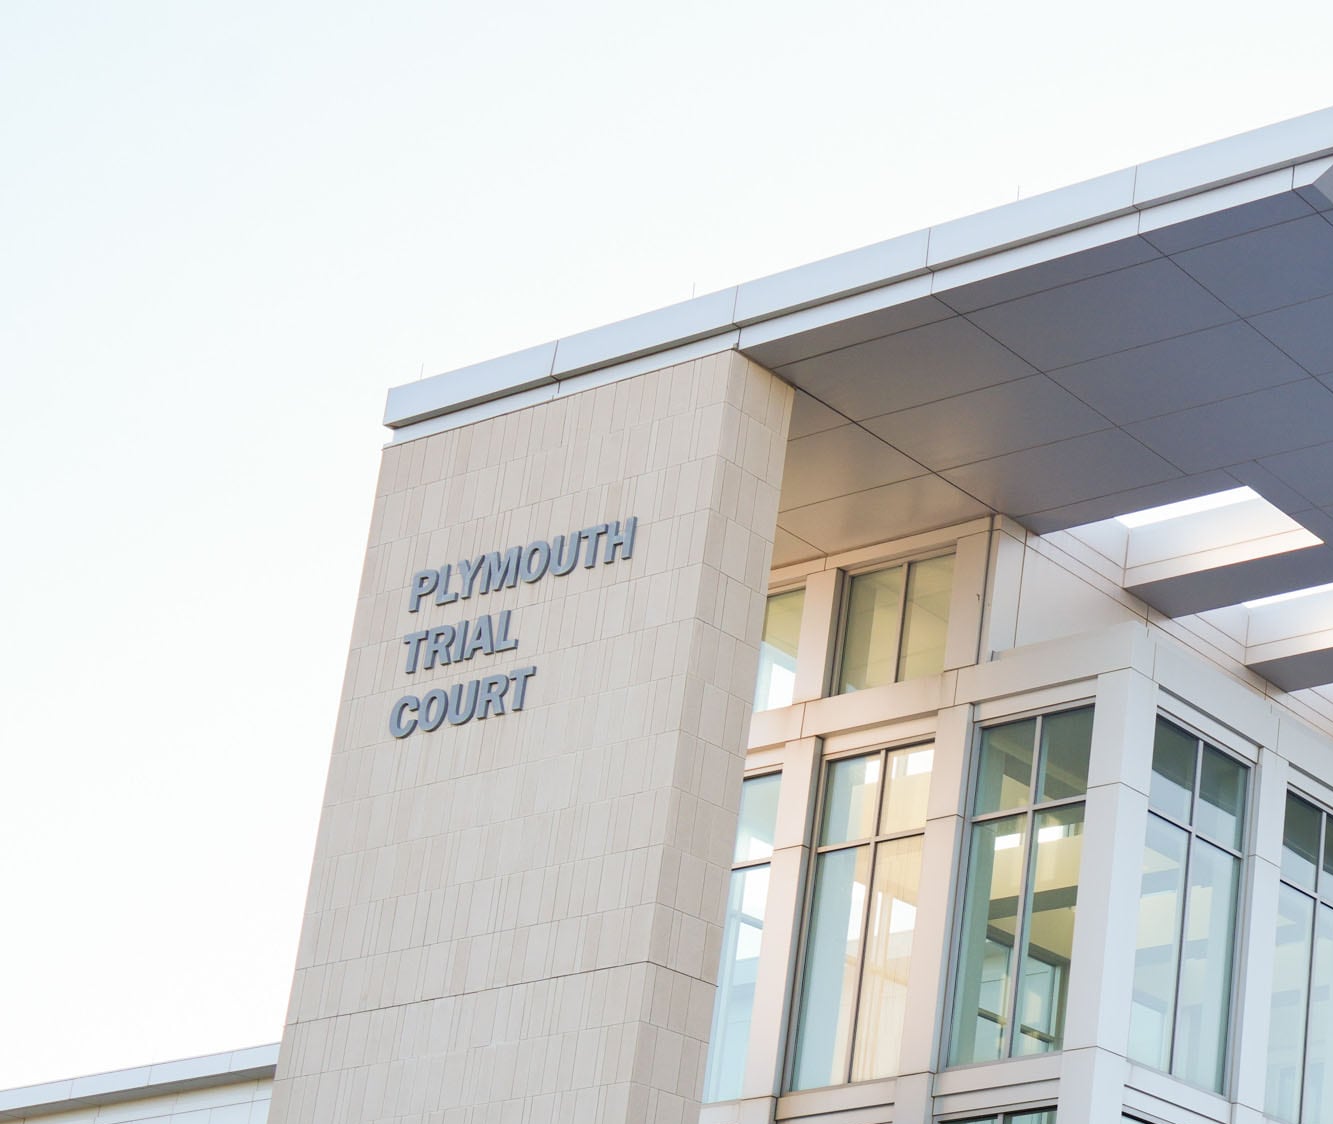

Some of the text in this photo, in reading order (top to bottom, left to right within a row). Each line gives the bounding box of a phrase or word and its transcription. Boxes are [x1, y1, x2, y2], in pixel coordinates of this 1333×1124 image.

[408, 516, 638, 613] PLYMOUTH
[403, 610, 519, 674] TRIAL
[389, 666, 537, 739] COURT
